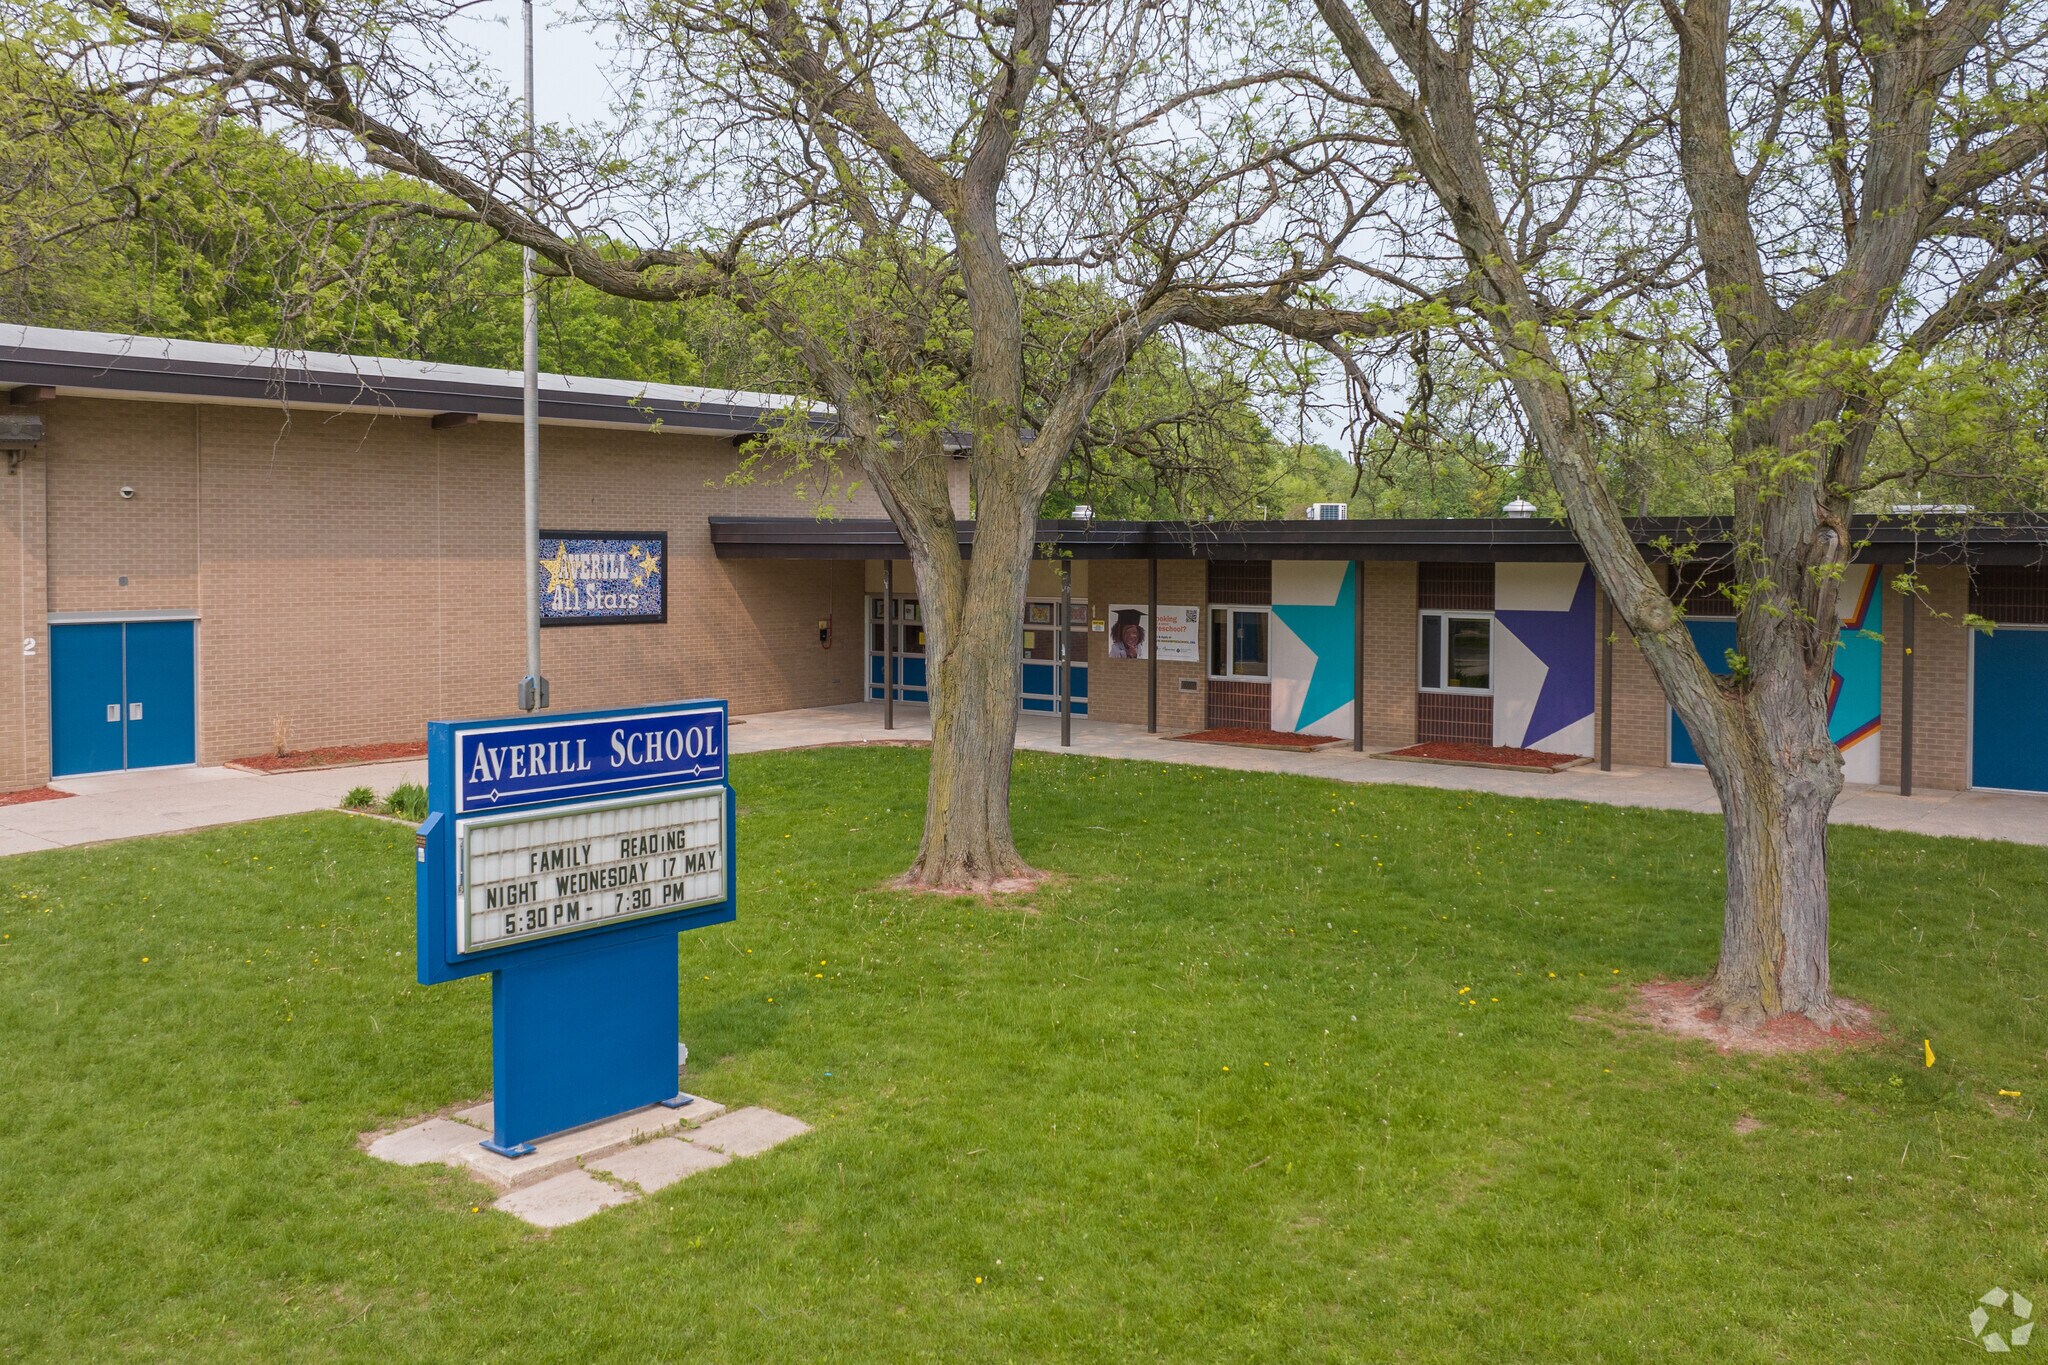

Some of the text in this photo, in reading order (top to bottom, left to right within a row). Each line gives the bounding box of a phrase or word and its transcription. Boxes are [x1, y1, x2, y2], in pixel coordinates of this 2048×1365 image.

[558, 553, 628, 580] AVERILL
[552, 583, 639, 611] All Stars
[1156, 616, 1177, 624] ooking
[23, 637, 36, 656] 2
[468, 725, 719, 783] AVERILL SCHOOL
[531, 830, 685, 873] FAMILY READING
[486, 850, 717, 909] NIGHT WEDNESDAY 17 MAY
[505, 907, 547, 935] 5:30
[554, 902, 580, 925] PM
[616, 888, 651, 912] 7:30
[663, 882, 684, 904] PM
